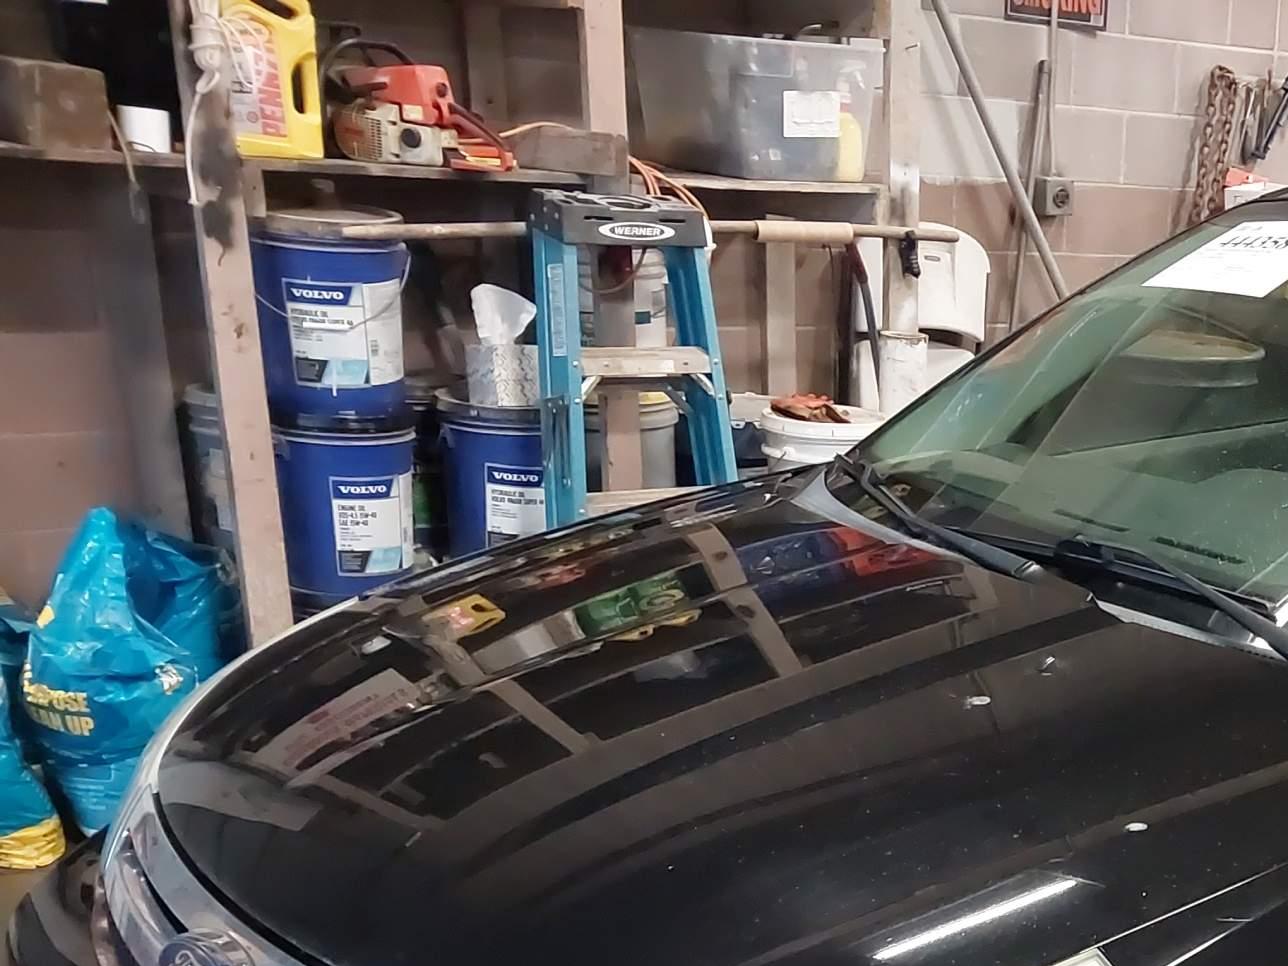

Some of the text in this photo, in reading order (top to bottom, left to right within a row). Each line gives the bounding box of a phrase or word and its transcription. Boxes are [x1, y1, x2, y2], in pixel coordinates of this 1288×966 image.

[614, 226, 662, 236] WERNER
[290, 288, 344, 299] VOLVO
[492, 472, 539, 482] VOLVO
[65, 715, 95, 737] UP
